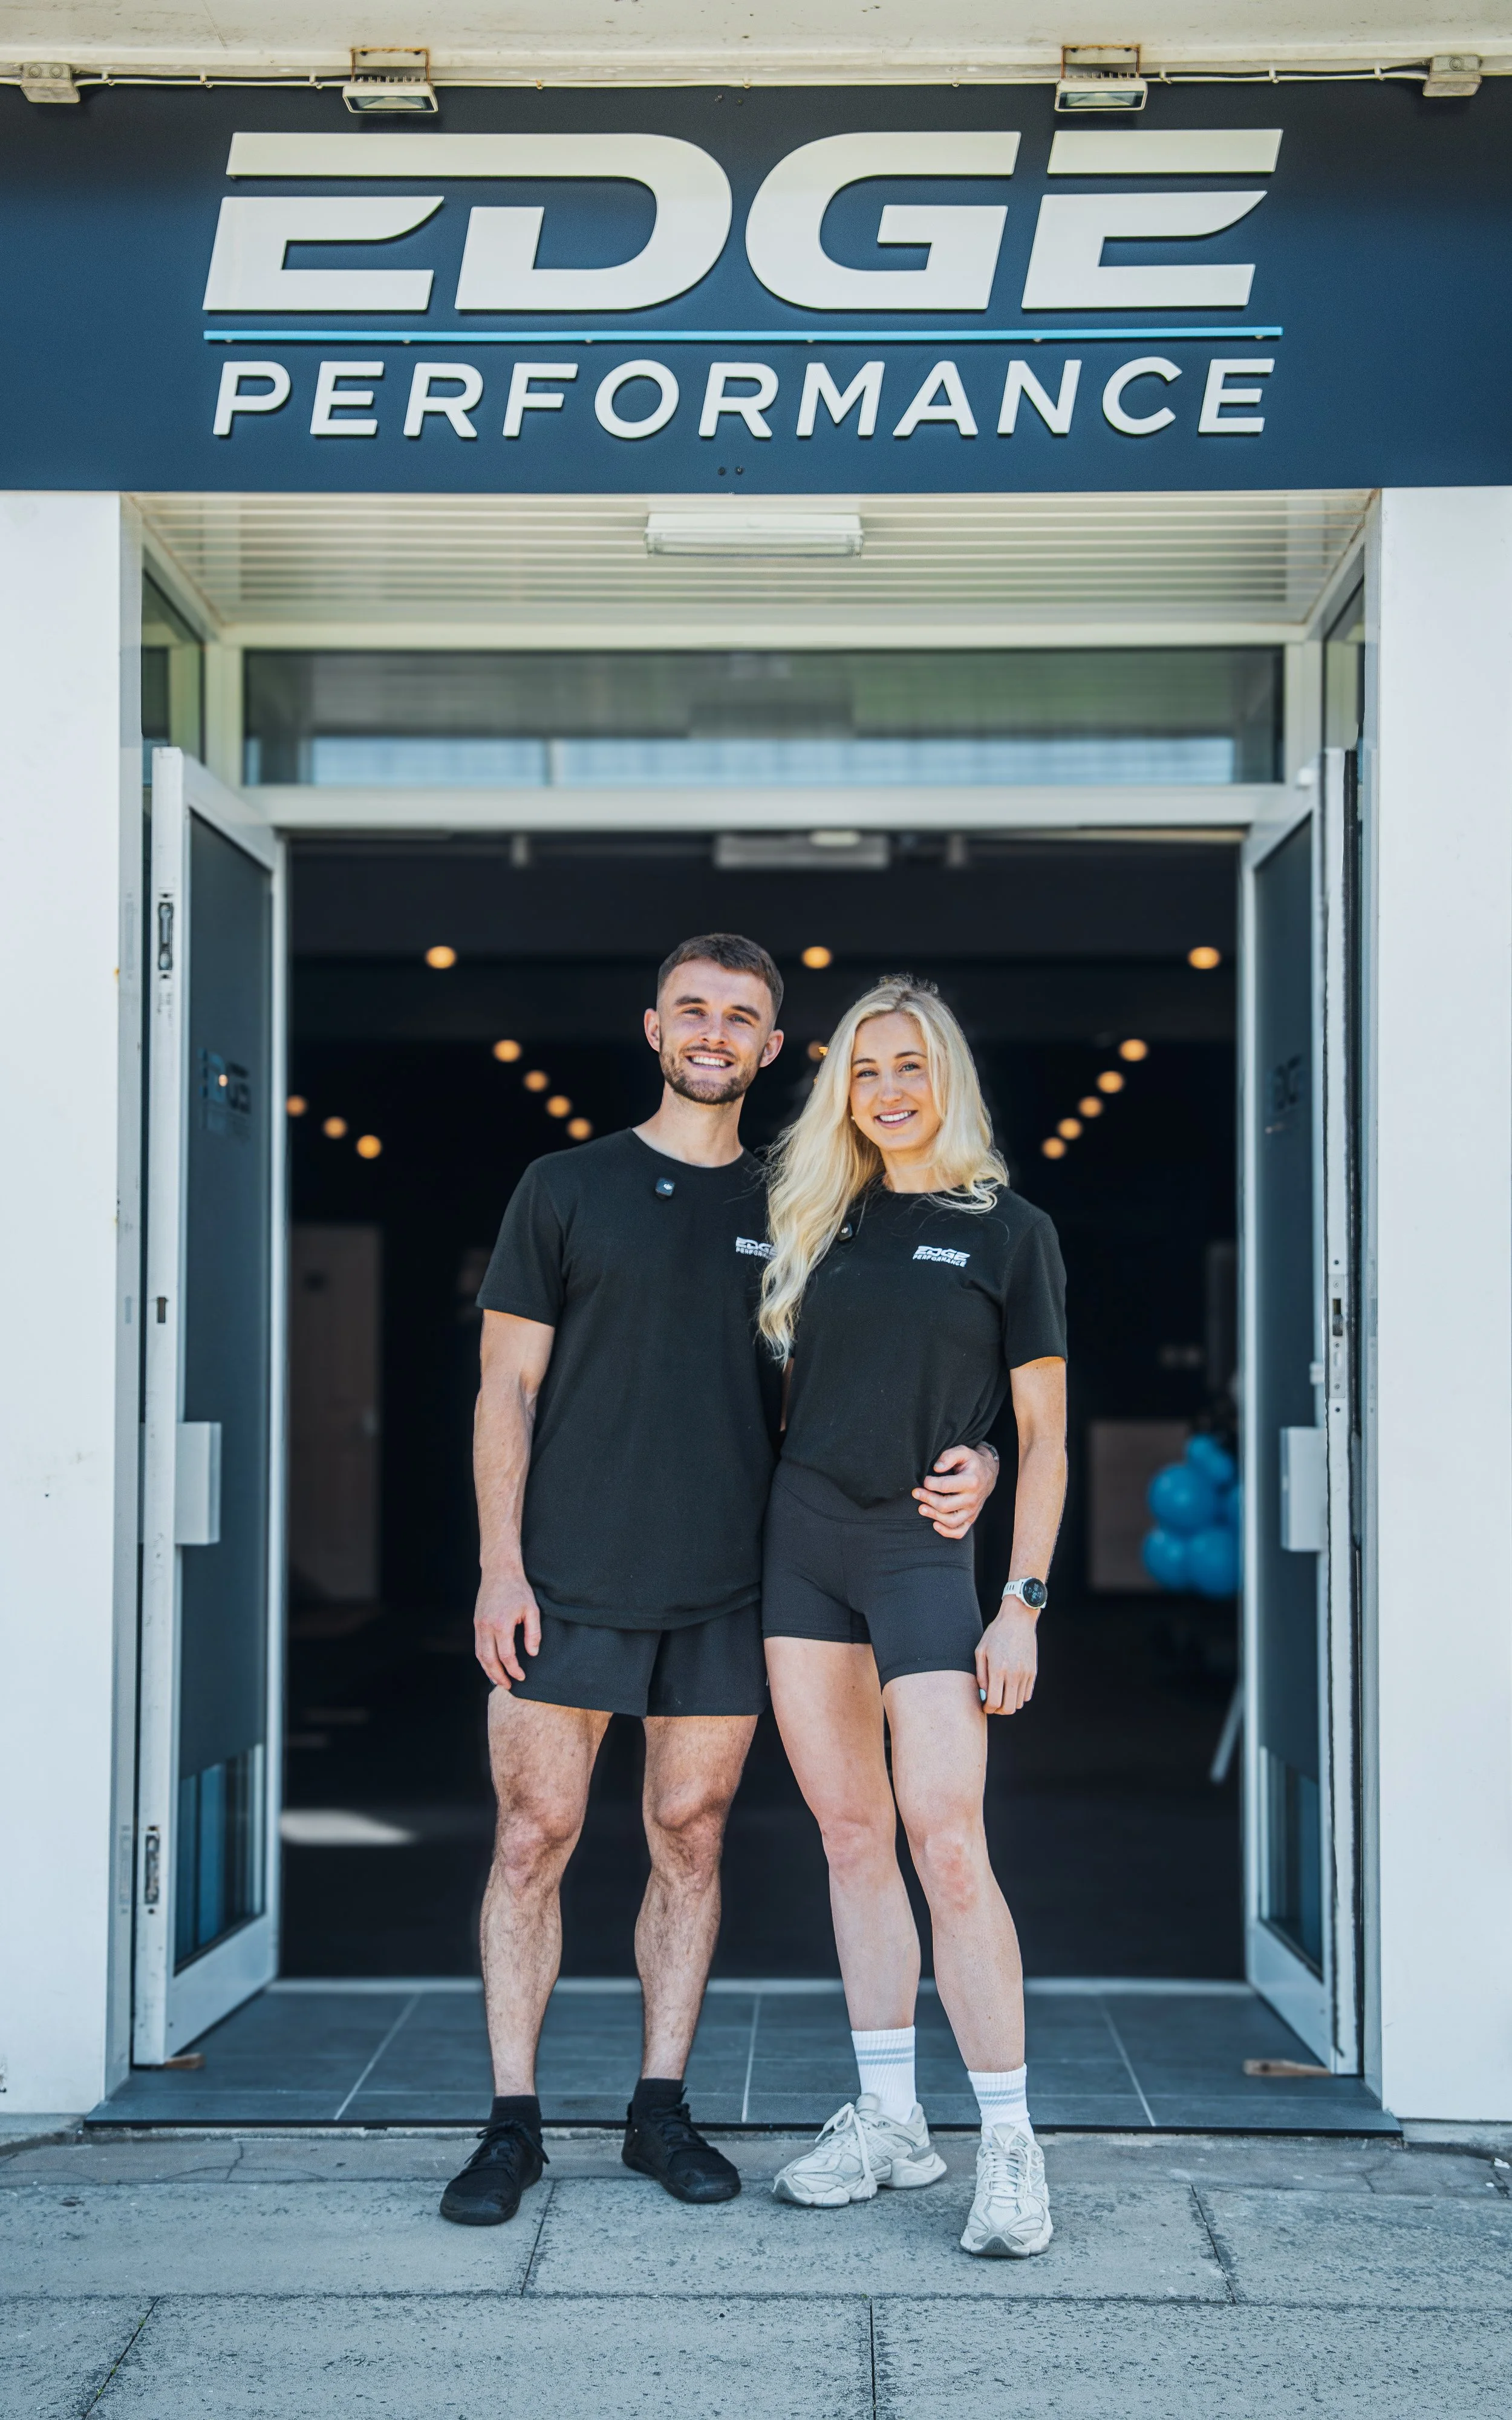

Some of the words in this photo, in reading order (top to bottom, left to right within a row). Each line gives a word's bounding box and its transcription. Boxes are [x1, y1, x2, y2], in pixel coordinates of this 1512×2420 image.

[202, 128, 1282, 311] EDGE
[213, 356, 1276, 439] PERFORMANCE
[912, 1254, 967, 1267] PERFORMANCE
[914, 1246, 971, 1261] EDGE
